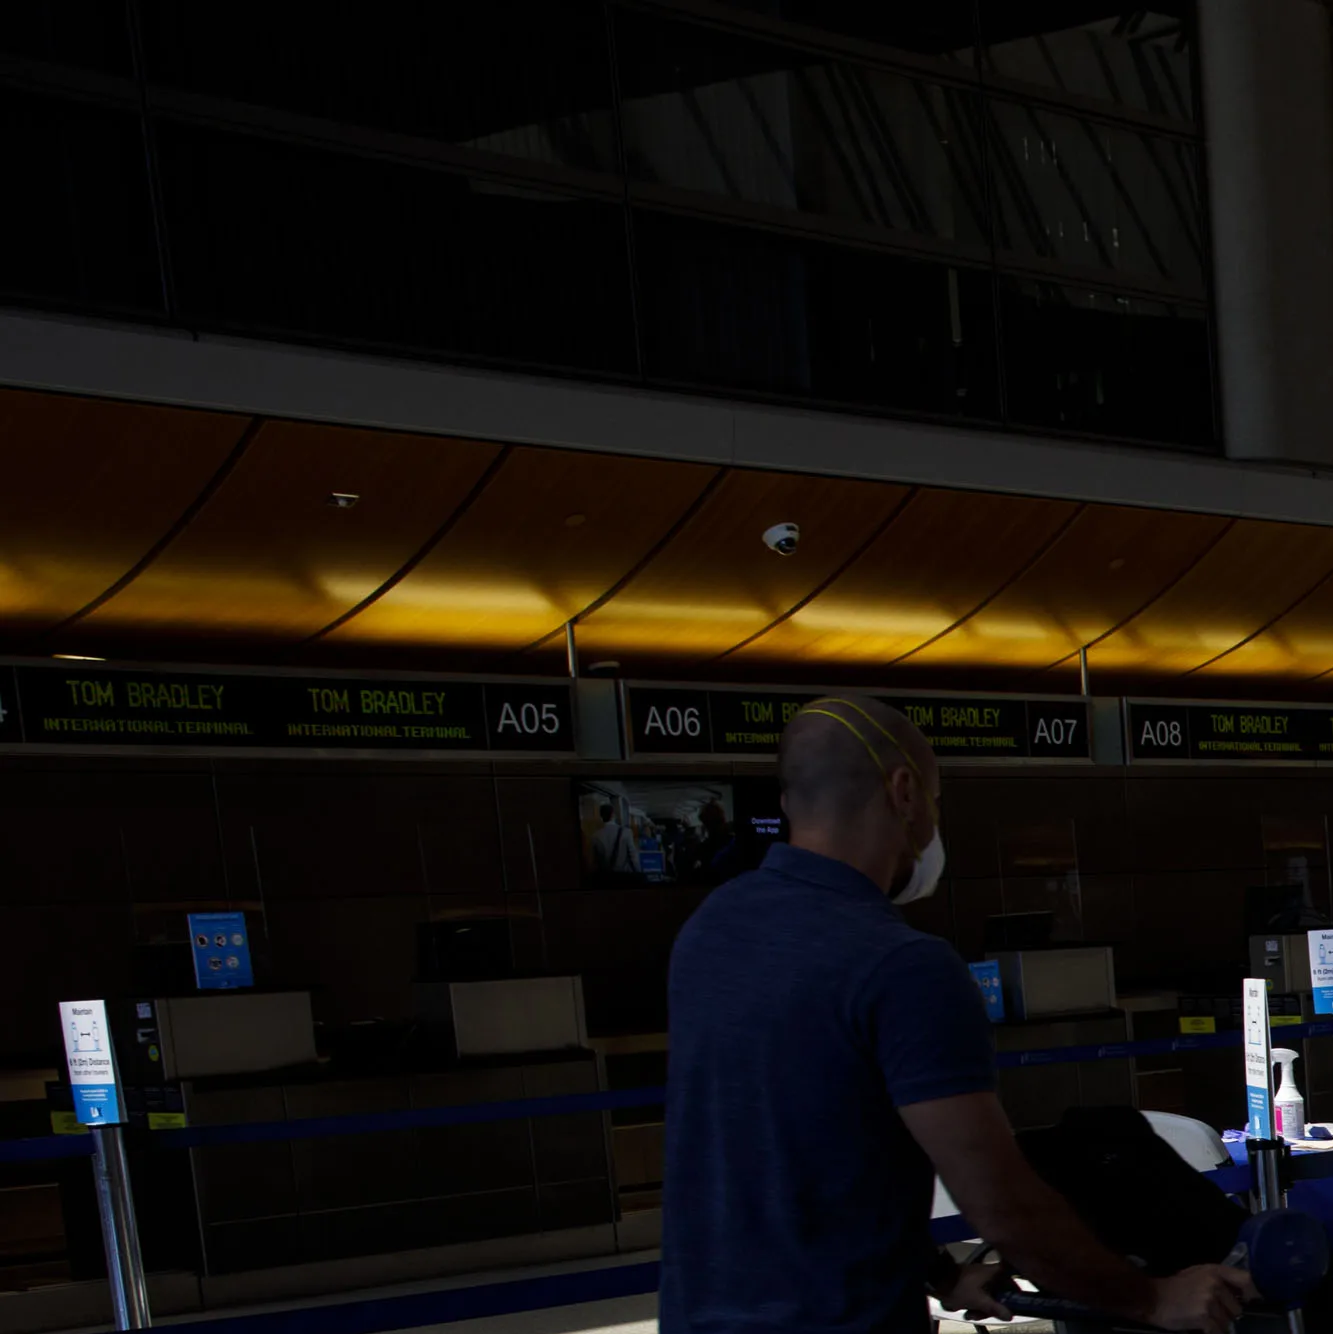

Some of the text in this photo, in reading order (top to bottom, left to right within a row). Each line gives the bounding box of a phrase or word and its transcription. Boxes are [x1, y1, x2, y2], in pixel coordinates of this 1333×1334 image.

[66, 679, 224, 711] TOM BRADLEY
[308, 687, 445, 717] TOM BRADLEY
[497, 701, 560, 736] A05
[644, 705, 700, 738] A06
[741, 701, 774, 724] TOM
[905, 705, 1000, 728] TOM BRADLEY
[1210, 713, 1288, 735] TOM BRADLEY
[1034, 718, 1077, 745] A07
[1140, 719, 1182, 746] A08
[72, 1007, 93, 1016] Maintain
